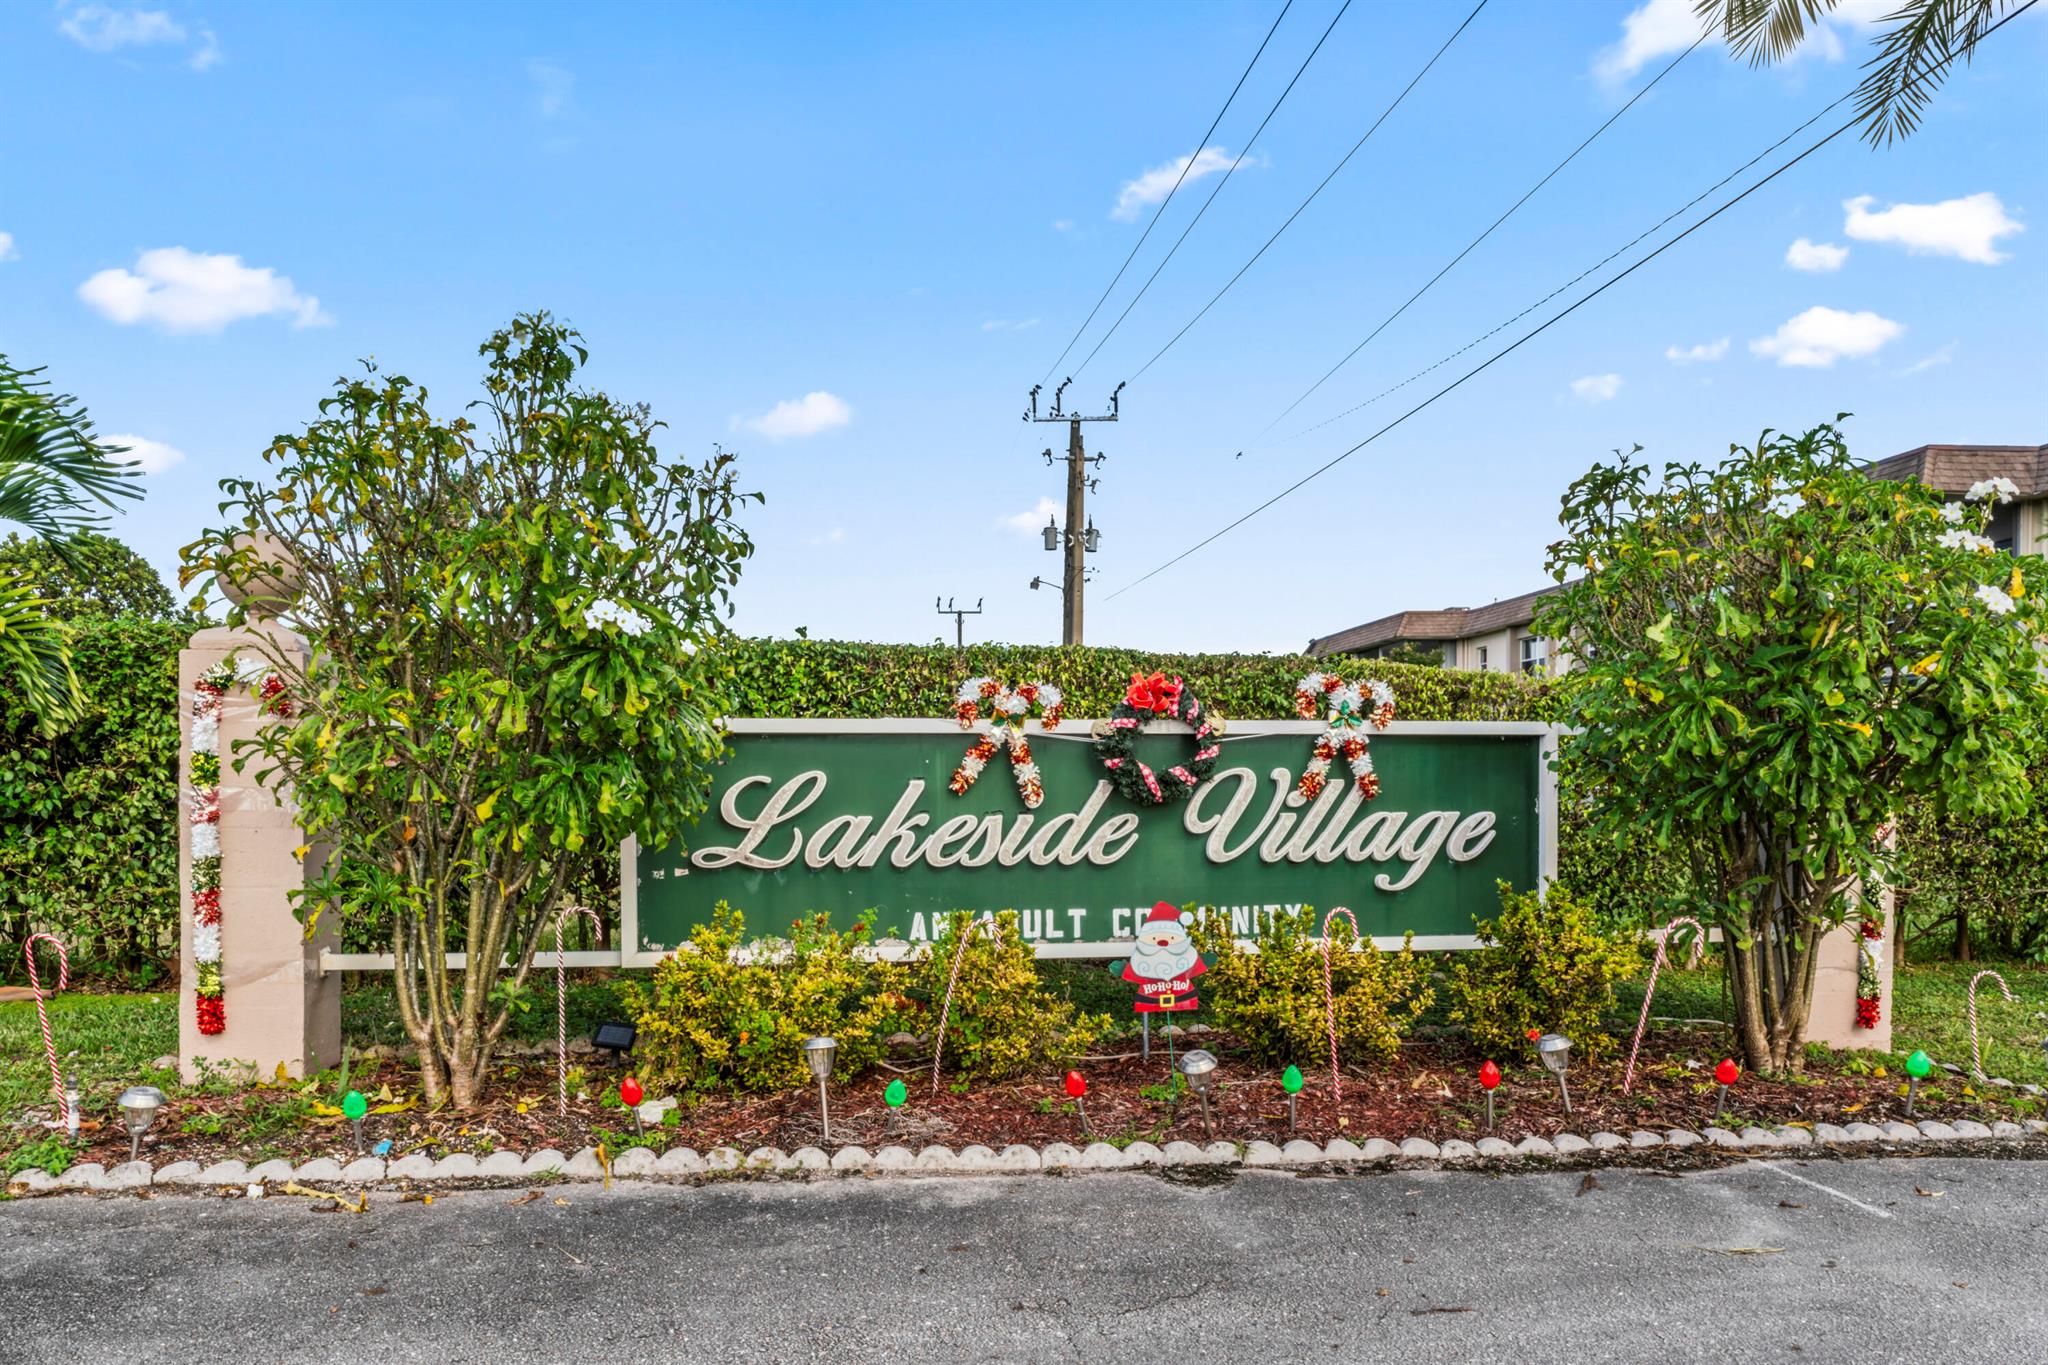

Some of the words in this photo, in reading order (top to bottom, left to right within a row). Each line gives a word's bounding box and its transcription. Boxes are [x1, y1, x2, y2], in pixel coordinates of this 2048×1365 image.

[691, 770, 1139, 868] Lakeside
[1183, 767, 1496, 892] Village
[977, 908, 1087, 939] AULT
[1112, 904, 1302, 937] CNITY
